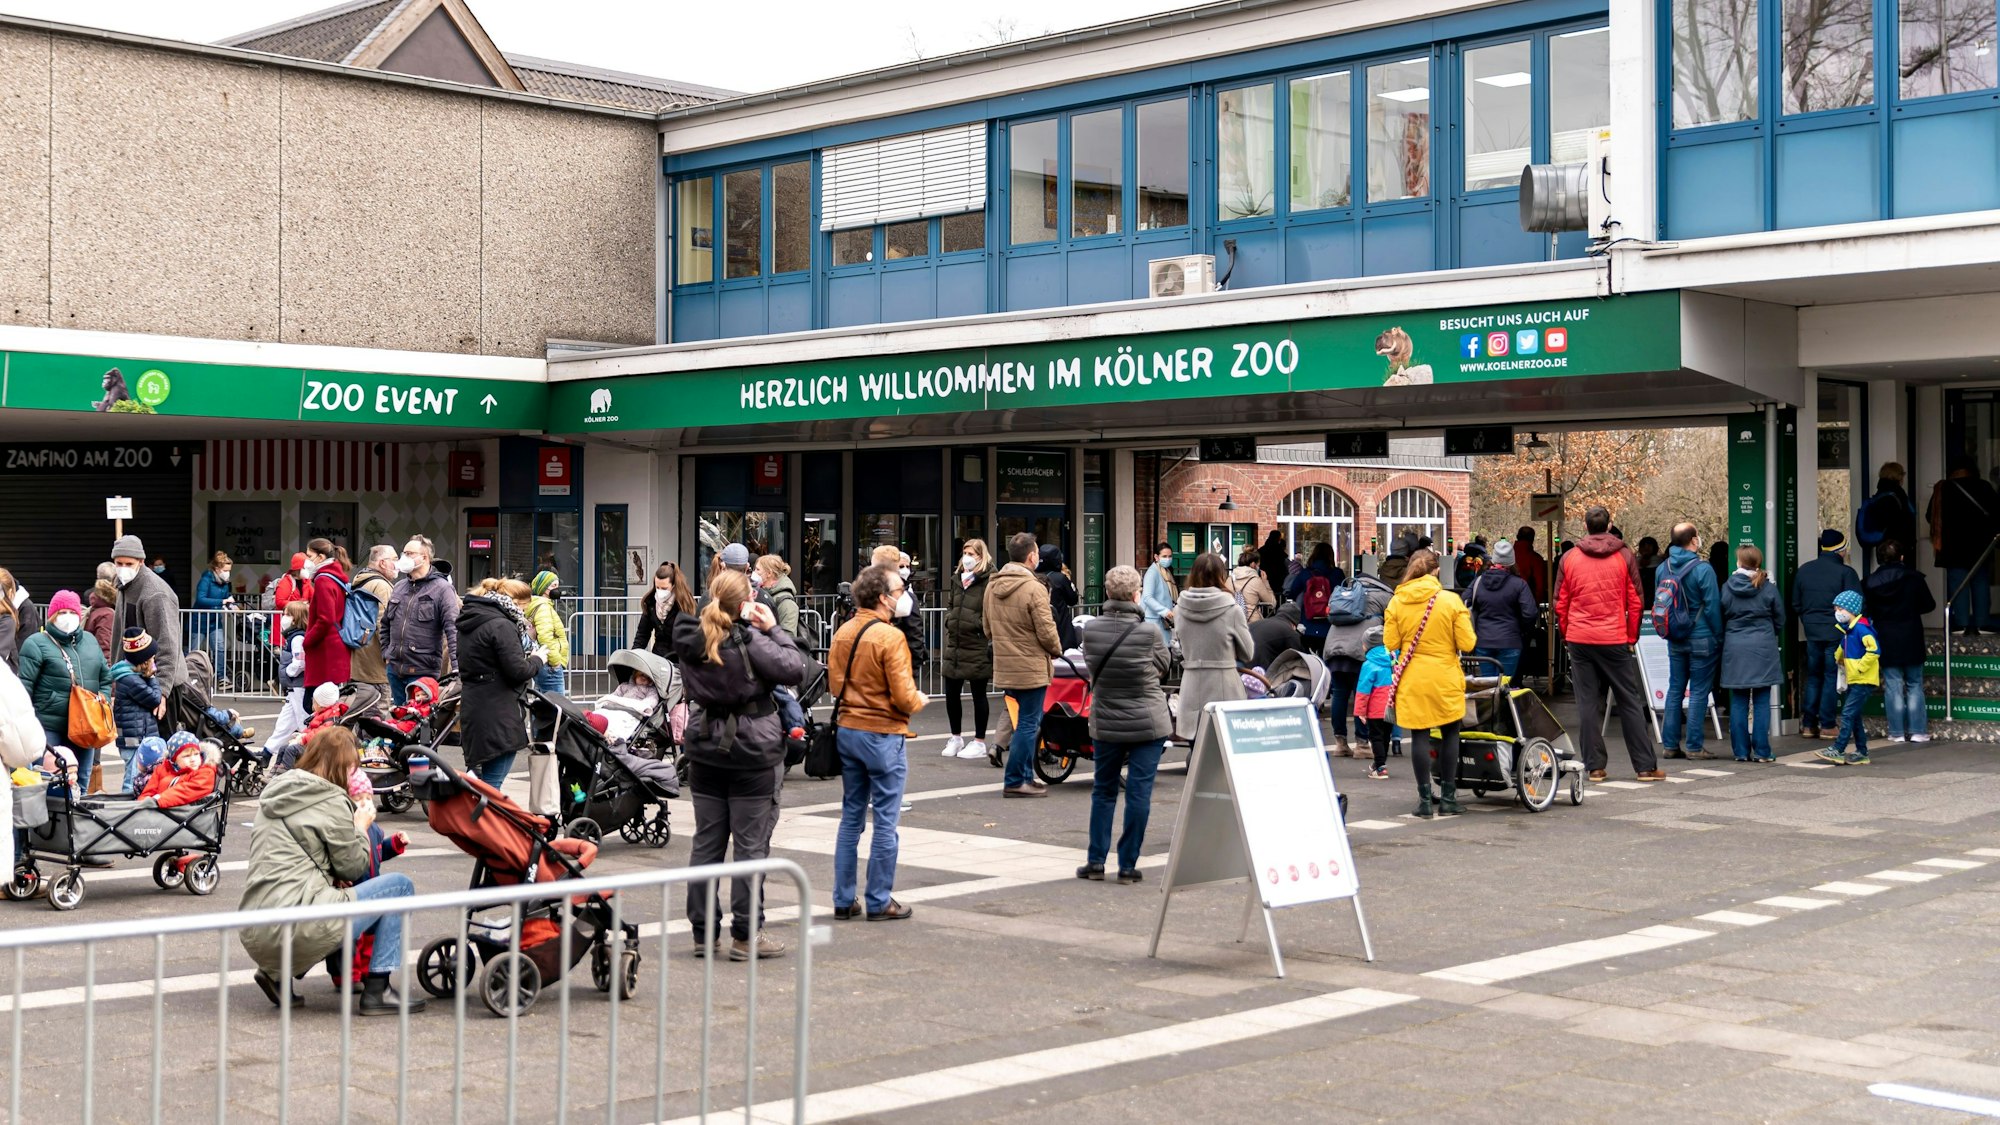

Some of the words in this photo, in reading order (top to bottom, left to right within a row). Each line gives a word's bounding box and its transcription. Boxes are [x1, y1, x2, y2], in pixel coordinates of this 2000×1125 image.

[1440, 316, 1494, 330] BESUCHT
[1497, 313, 1522, 326] UNS
[1525, 311, 1561, 324] AUCH
[1564, 309, 1590, 321] AUF
[1460, 357, 1568, 373] WWW.KOELNERZOO.DE
[740, 375, 848, 409] HERZLICH
[858, 361, 1035, 401] WILLKOMMEN
[1048, 357, 1081, 390] IM
[1094, 345, 1214, 387] KÖLNER
[1230, 339, 1300, 378] ZOO
[303, 381, 365, 412] ZOO
[375, 384, 459, 415] EVENT
[1818, 431, 1849, 442] KASS
[5, 449, 79, 468] ZANFINO
[82, 450, 109, 467] AM
[112, 446, 153, 468] ZOO
[225, 526, 264, 537] ZANFINO
[310, 527, 348, 538] ZANFINO
[234, 545, 255, 557] ZOO
[1231, 718, 1265, 732] Wichtige
[1265, 715, 1303, 728] Hinweise
